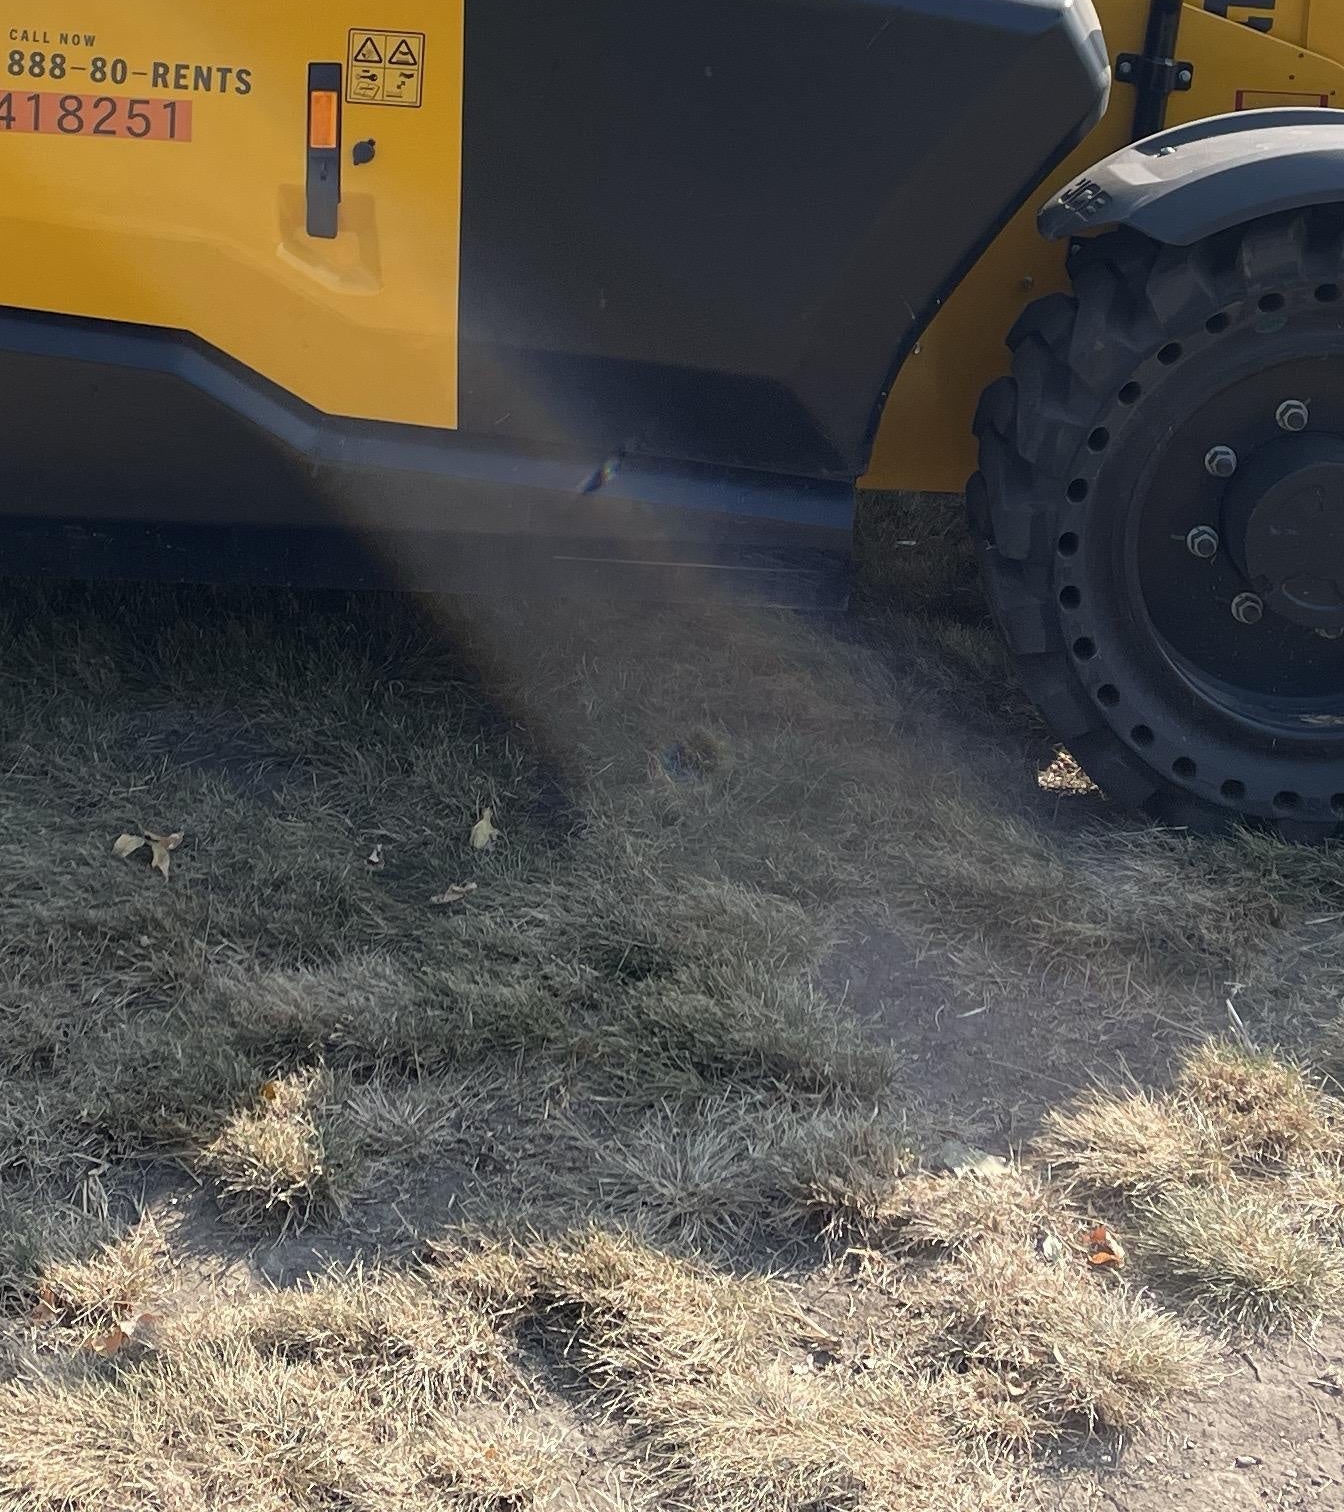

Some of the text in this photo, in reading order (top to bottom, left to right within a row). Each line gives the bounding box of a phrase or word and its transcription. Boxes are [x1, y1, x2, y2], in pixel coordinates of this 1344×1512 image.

[9, 28, 96, 47] CALL NOW
[7, 49, 252, 95] 888-80-RENTS
